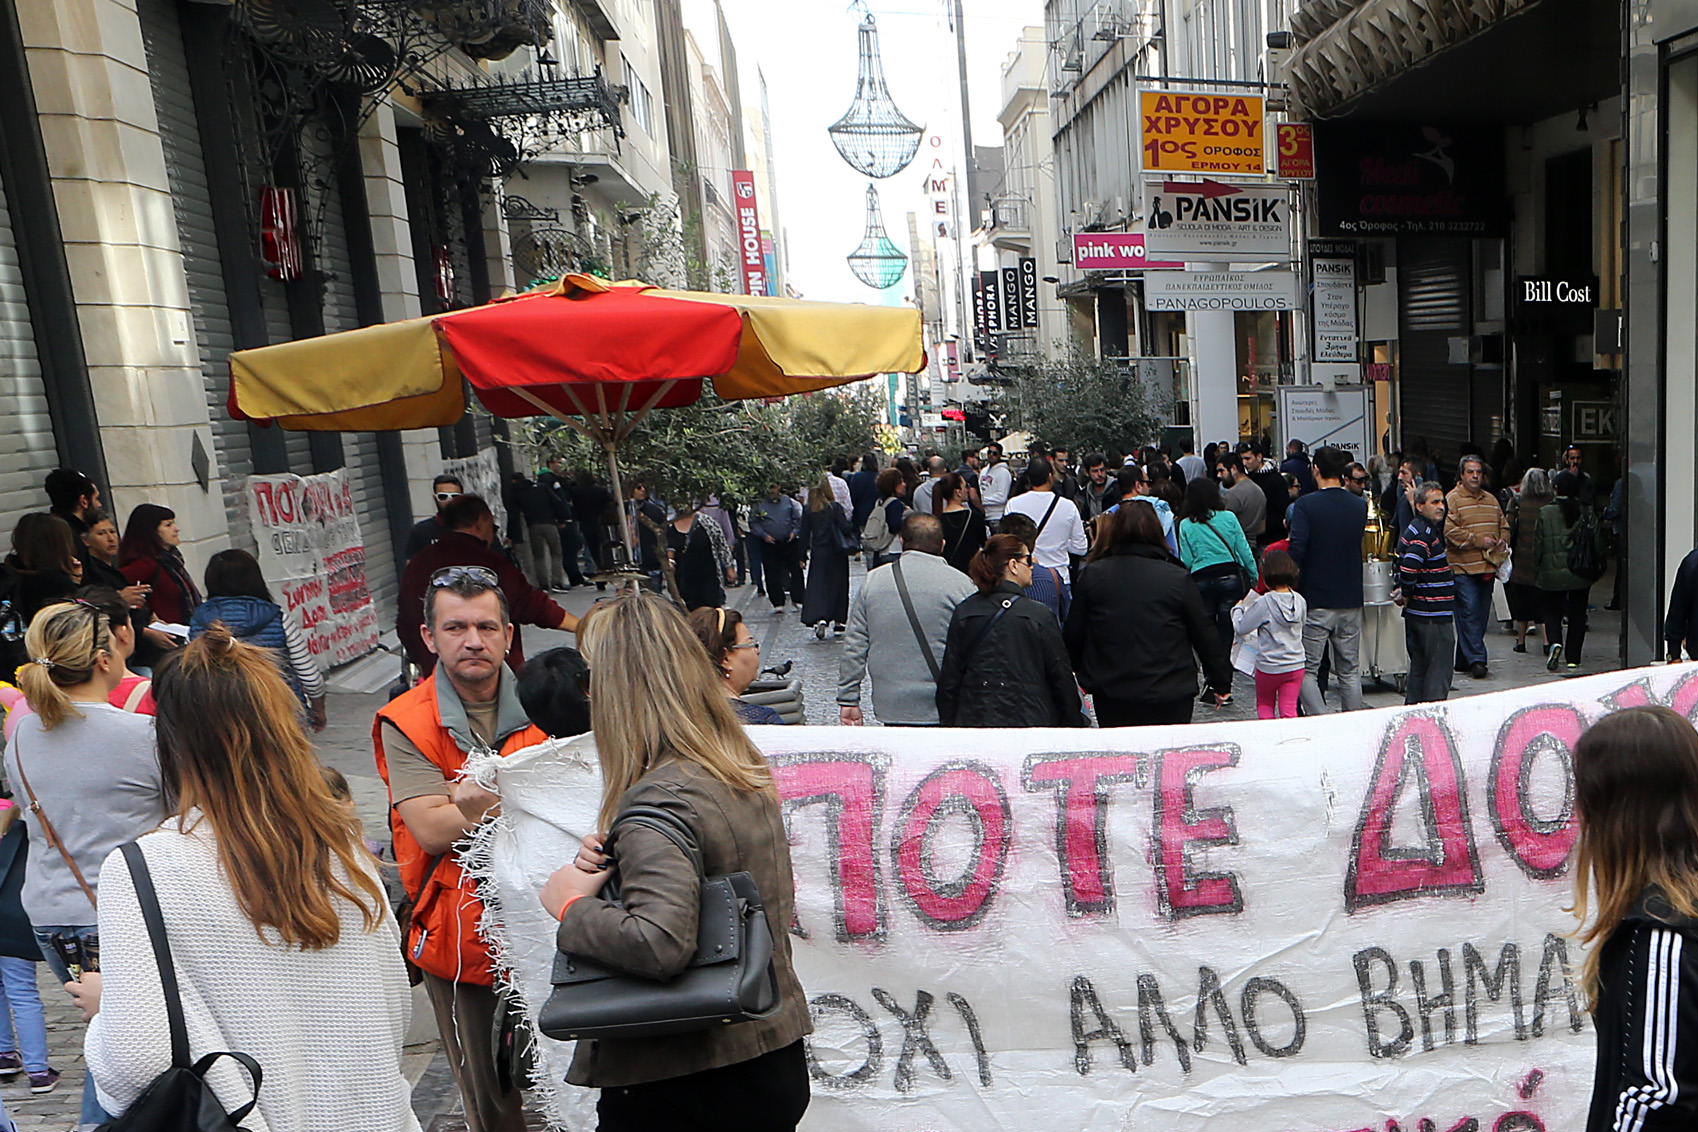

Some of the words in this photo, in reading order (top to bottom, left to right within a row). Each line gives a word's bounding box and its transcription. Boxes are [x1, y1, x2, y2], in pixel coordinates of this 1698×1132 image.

[1154, 95, 1249, 117] ΑΓΟΡΑ
[1144, 115, 1260, 138] ΧΡΥΣΟΥ
[1144, 138, 1198, 168] 1ος
[1203, 146, 1261, 158] ΟΡΟΦΟΣ
[1191, 161, 1241, 171] ΕΡΜΟΥ
[1245, 163, 1262, 171] 14
[740, 207, 761, 265] HOUSE
[1176, 223, 1202, 231] SCUOLA
[1339, 220, 1357, 232] 4ος
[1428, 221, 1445, 231] 210
[1078, 241, 1115, 262] pink
[1023, 260, 1037, 324] MANGO
[1243, 283, 1273, 291] ΟΜΙΛΟΣ
[1523, 280, 1552, 302] Bill
[1556, 281, 1592, 303] Cost
[1006, 270, 1019, 328] MANGO
[1156, 297, 1286, 310] PANAGOPOULOS
[804, 984, 993, 1092] ΟΧΙ
[1067, 965, 1307, 1077] ΑΛΛΟ
[1352, 932, 1585, 1060] ΒΗΜΑ
